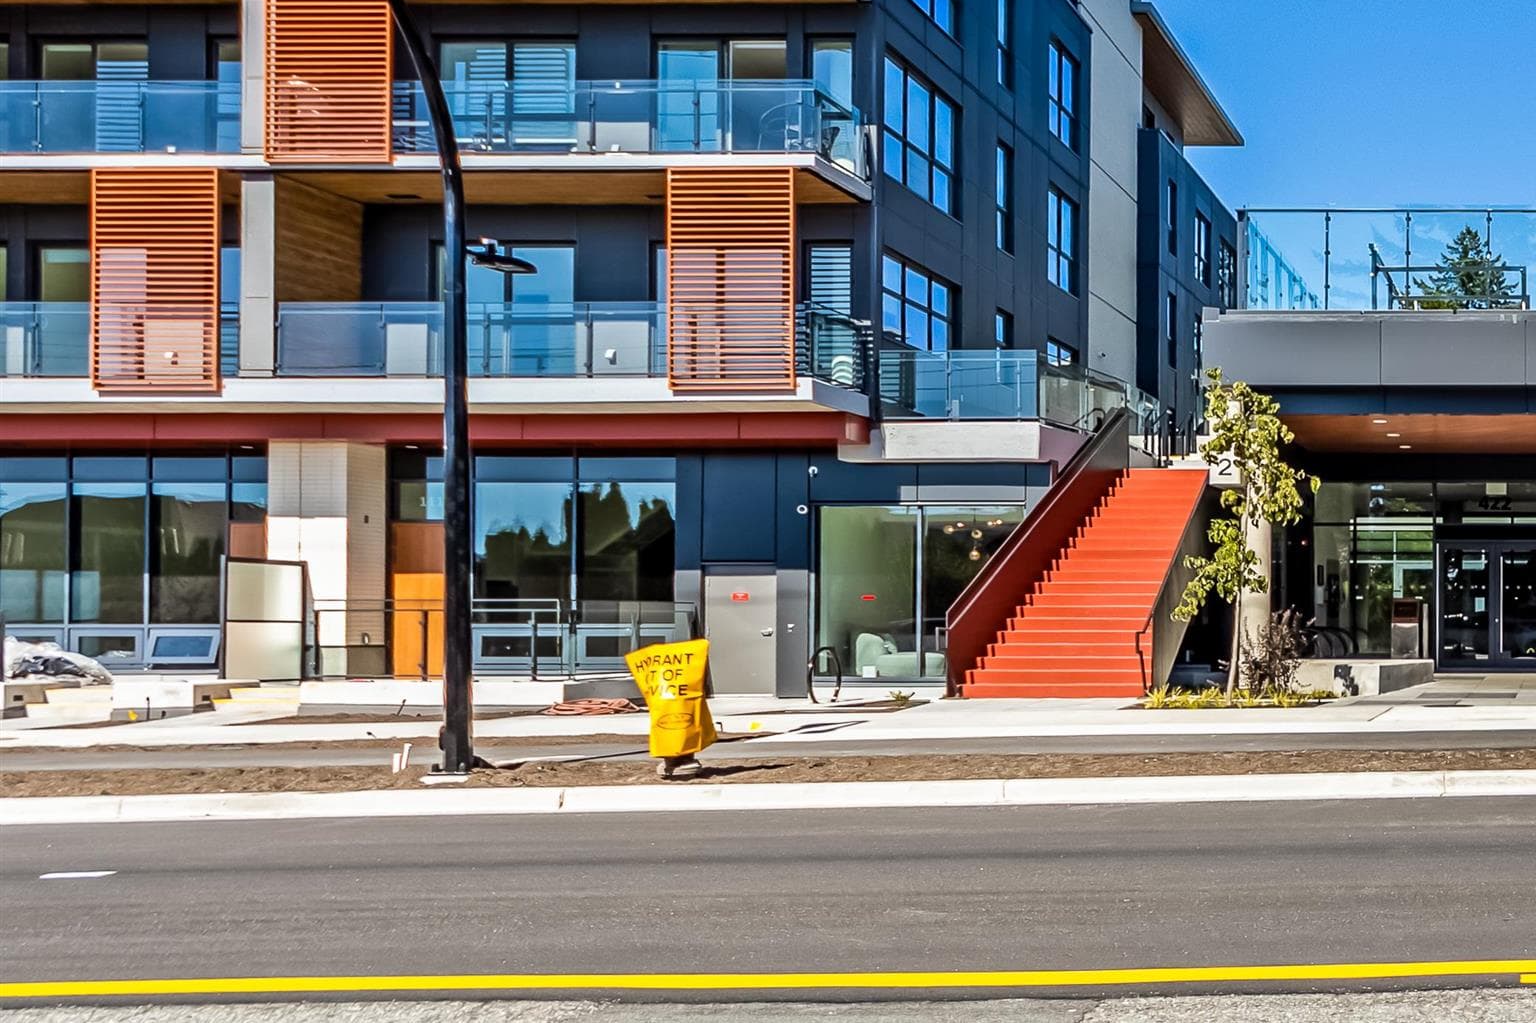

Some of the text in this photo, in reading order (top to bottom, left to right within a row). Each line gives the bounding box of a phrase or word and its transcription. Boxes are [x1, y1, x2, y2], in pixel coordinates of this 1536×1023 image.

[1218, 458, 1233, 476] 2
[1478, 496, 1513, 511] 422
[662, 668, 684, 682] OF
